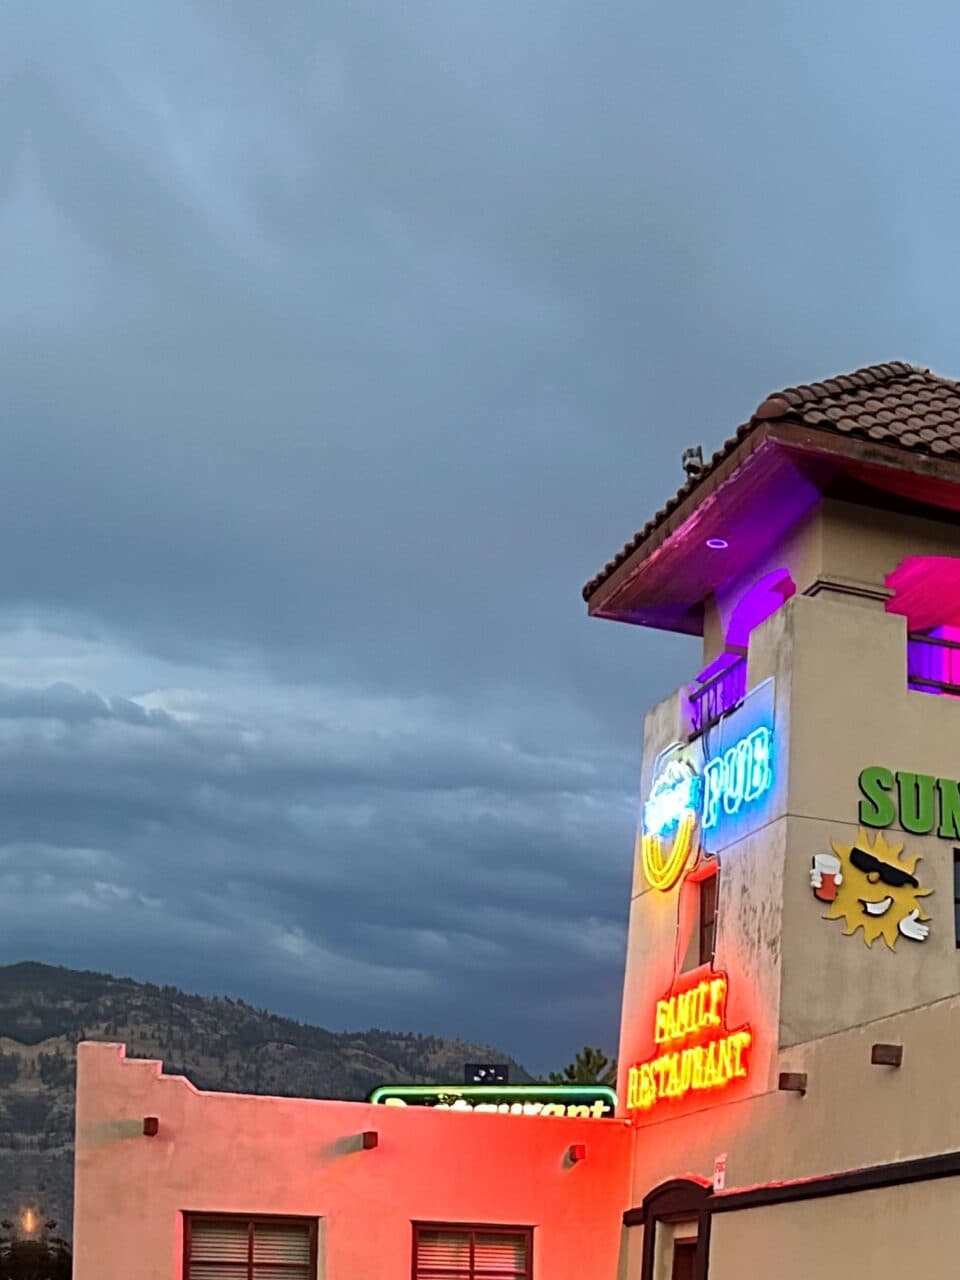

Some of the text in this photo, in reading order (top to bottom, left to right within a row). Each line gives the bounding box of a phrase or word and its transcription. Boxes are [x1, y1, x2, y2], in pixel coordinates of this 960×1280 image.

[702, 727, 772, 829] PUB
[655, 979, 725, 1043] FAMILY
[627, 1032, 751, 1109] RESTAURANT
